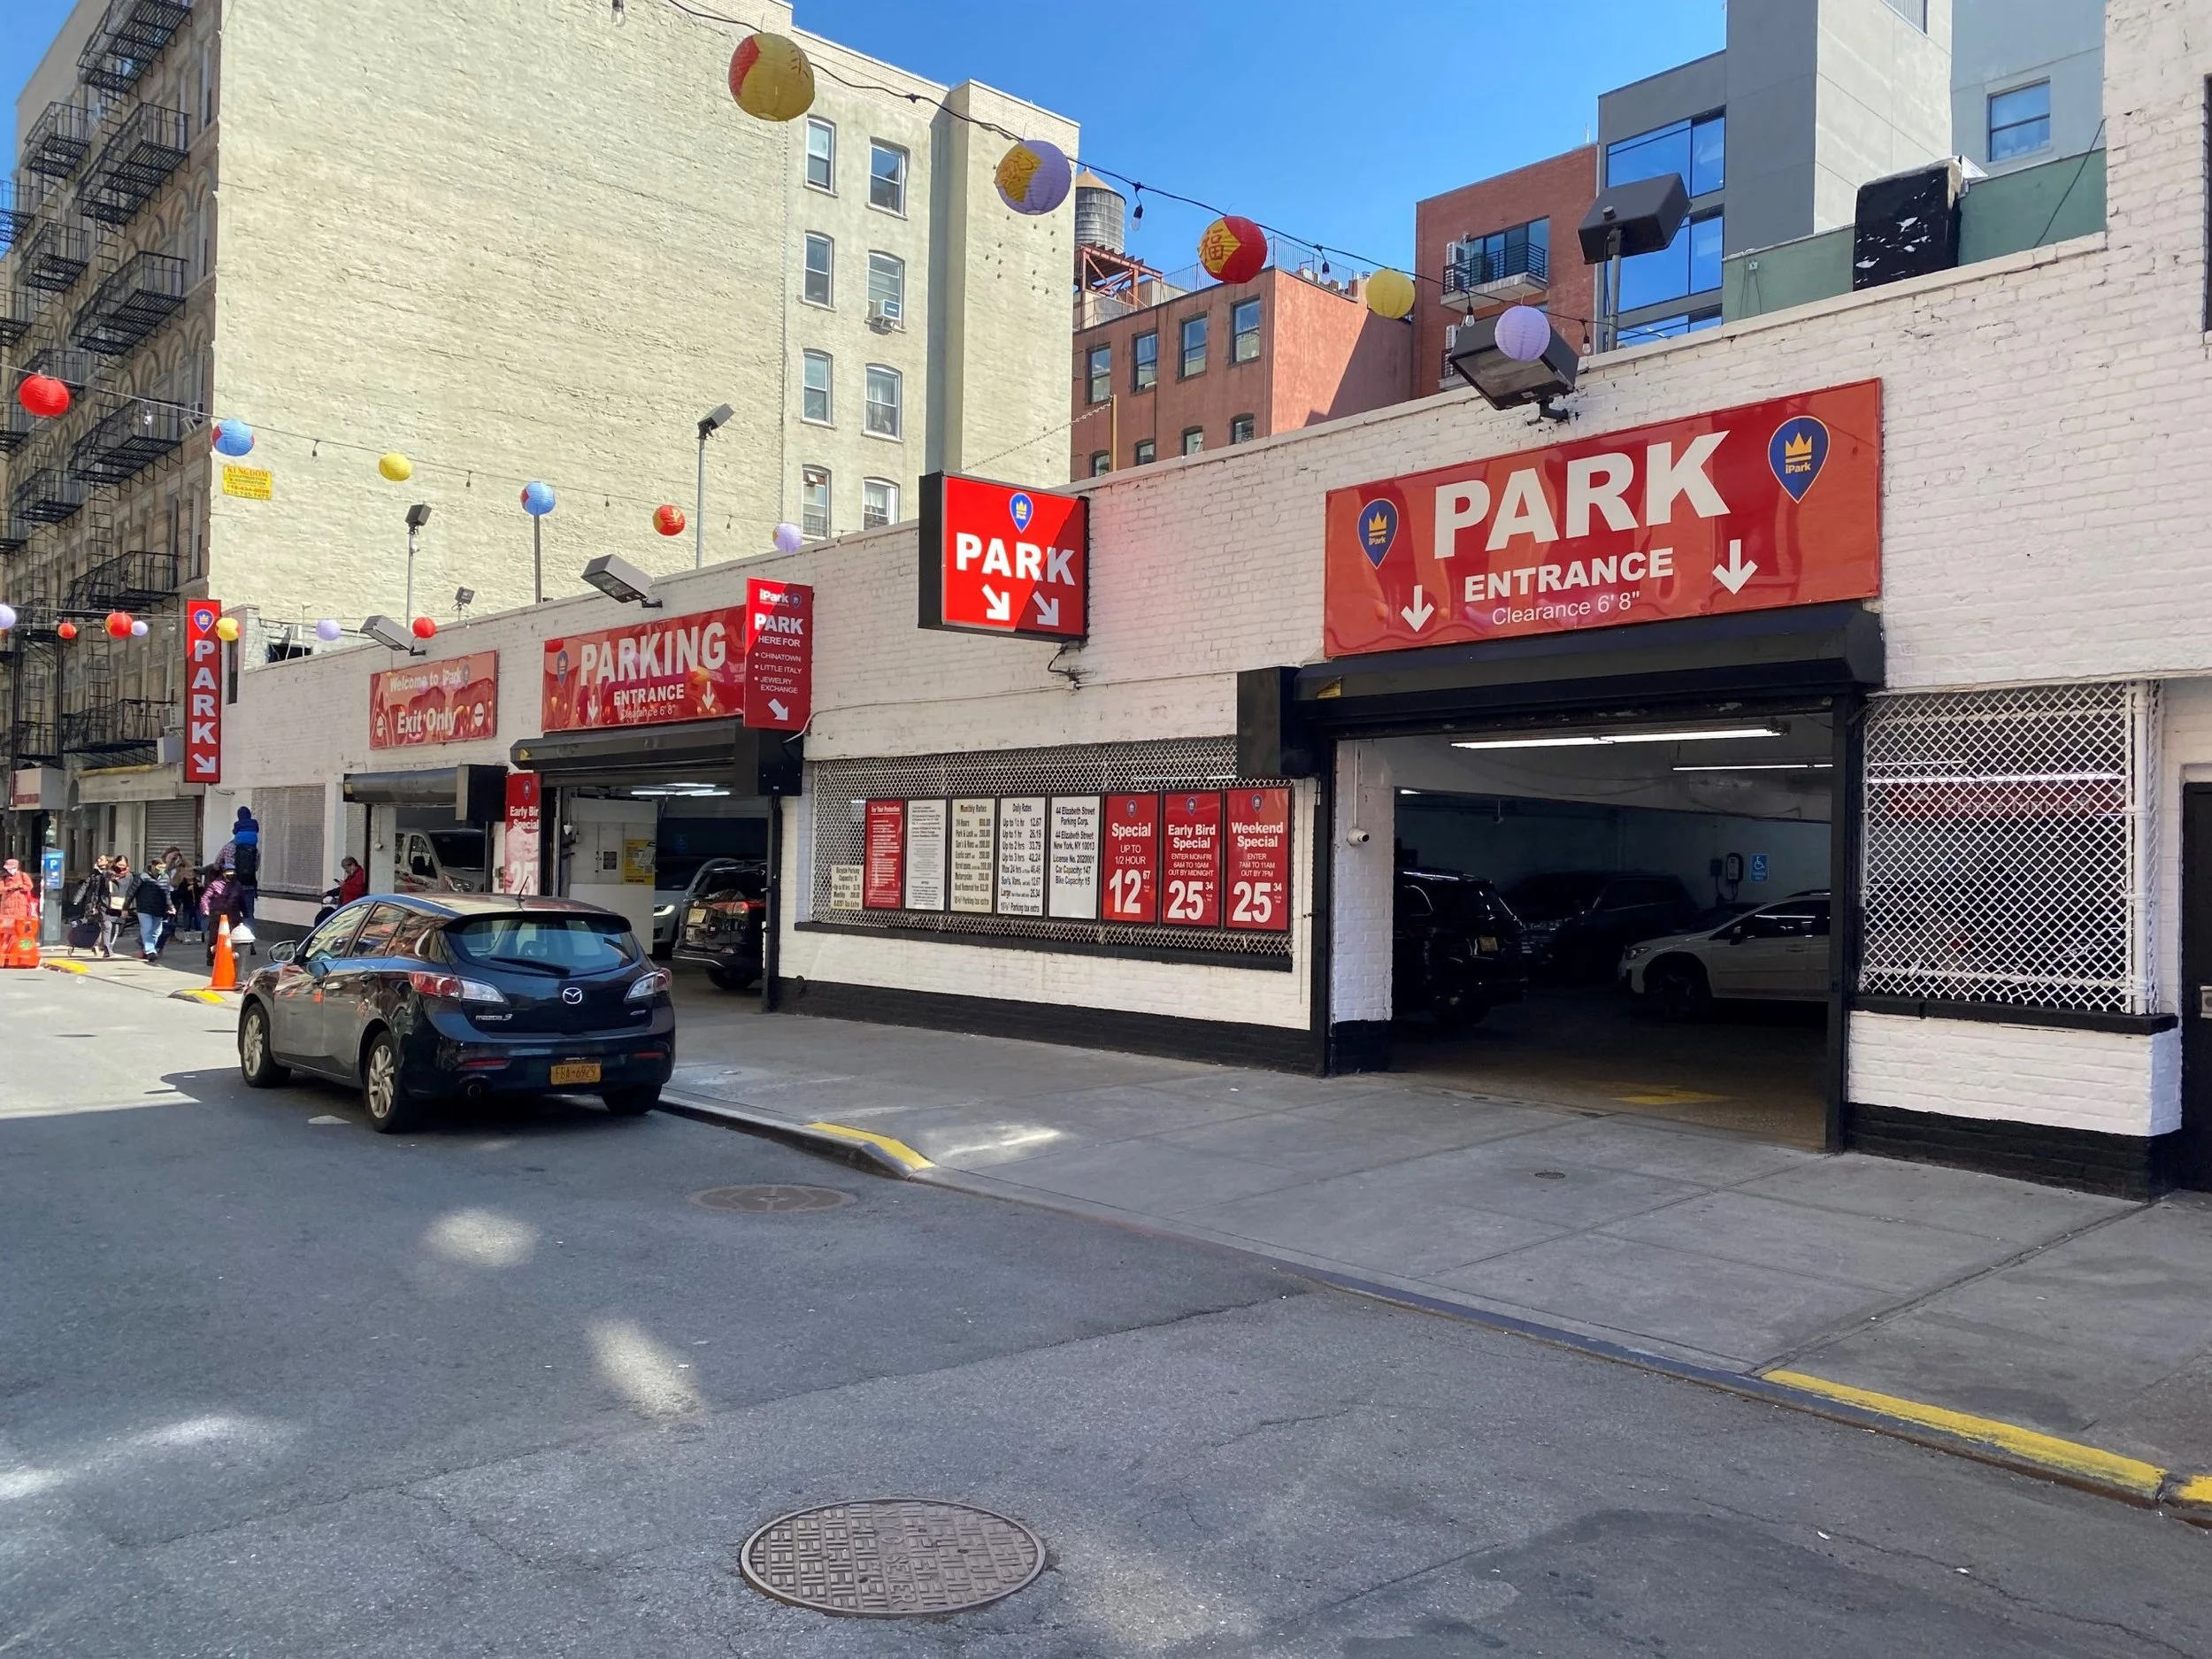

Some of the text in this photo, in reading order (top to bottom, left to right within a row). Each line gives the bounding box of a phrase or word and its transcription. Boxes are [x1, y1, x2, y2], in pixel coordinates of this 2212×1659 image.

[227, 466, 269, 479] KINGDOM
[1785, 462, 1812, 475] iPark
[1434, 430, 1731, 559] PARK
[1369, 535, 1386, 546] iPark
[956, 532, 1076, 586] PARK
[1464, 548, 1674, 603] ENTRANCE
[759, 588, 789, 603] iPark
[1492, 591, 1640, 626] Clearance 6' 8"
[755, 612, 803, 635] PARK
[758, 635, 801, 648] HERE FOR
[580, 621, 726, 686] PARKING
[761, 651, 802, 663] CHINATOWN
[760, 664, 782, 673] LITTLE
[390, 675, 427, 693] Welcome
[430, 672, 439, 686] to
[760, 676, 793, 685] JEWELRY
[191, 639, 217, 744] PARK
[613, 683, 684, 706] ENTRANCE
[760, 685, 798, 695] EXCHANGE
[621, 708, 658, 719] Clearance
[397, 706, 457, 736] Exit Only
[510, 805, 539, 818] Early Bir
[1012, 803, 1032, 814] Daily Rates
[1062, 806, 1080, 815] Elizabeth
[513, 818, 539, 830] Special
[1002, 818, 1009, 828] Up
[1030, 818, 1041, 826] 12.67
[1061, 818, 1088, 827] Parking Corp.
[1232, 822, 1284, 833] Weekend
[1002, 830, 1009, 841] Up
[1061, 831, 1079, 840] Elizabeth
[1080, 831, 1094, 840] Street
[1111, 822, 1152, 841] Special
[1168, 824, 1216, 838] Early Bird
[1002, 841, 1009, 852] Up
[1028, 841, 1041, 850] 33.79
[1064, 841, 1073, 850] York,
[1074, 841, 1081, 850] NY
[1081, 841, 1094, 850] 10013
[1172, 837, 1210, 851] Special
[1237, 835, 1278, 849] Special
[1120, 844, 1141, 854] UP TO
[50, 859, 58, 870] P
[1002, 853, 1009, 864] Up
[1028, 853, 1041, 863] 42.24
[1053, 854, 1069, 863] License
[1115, 856, 1146, 865] 1/2 HOUR
[1064, 865, 1082, 876] Capacity:
[1065, 876, 1084, 887] Capacity:
[1001, 888, 1011, 899] Large
[1109, 869, 1151, 914] 12 67
[1167, 879, 1213, 920] 25 34
[1232, 880, 1282, 923] 25 34
[1010, 902, 1024, 913] Parking
[885, 1554, 918, 1604] SEWER
